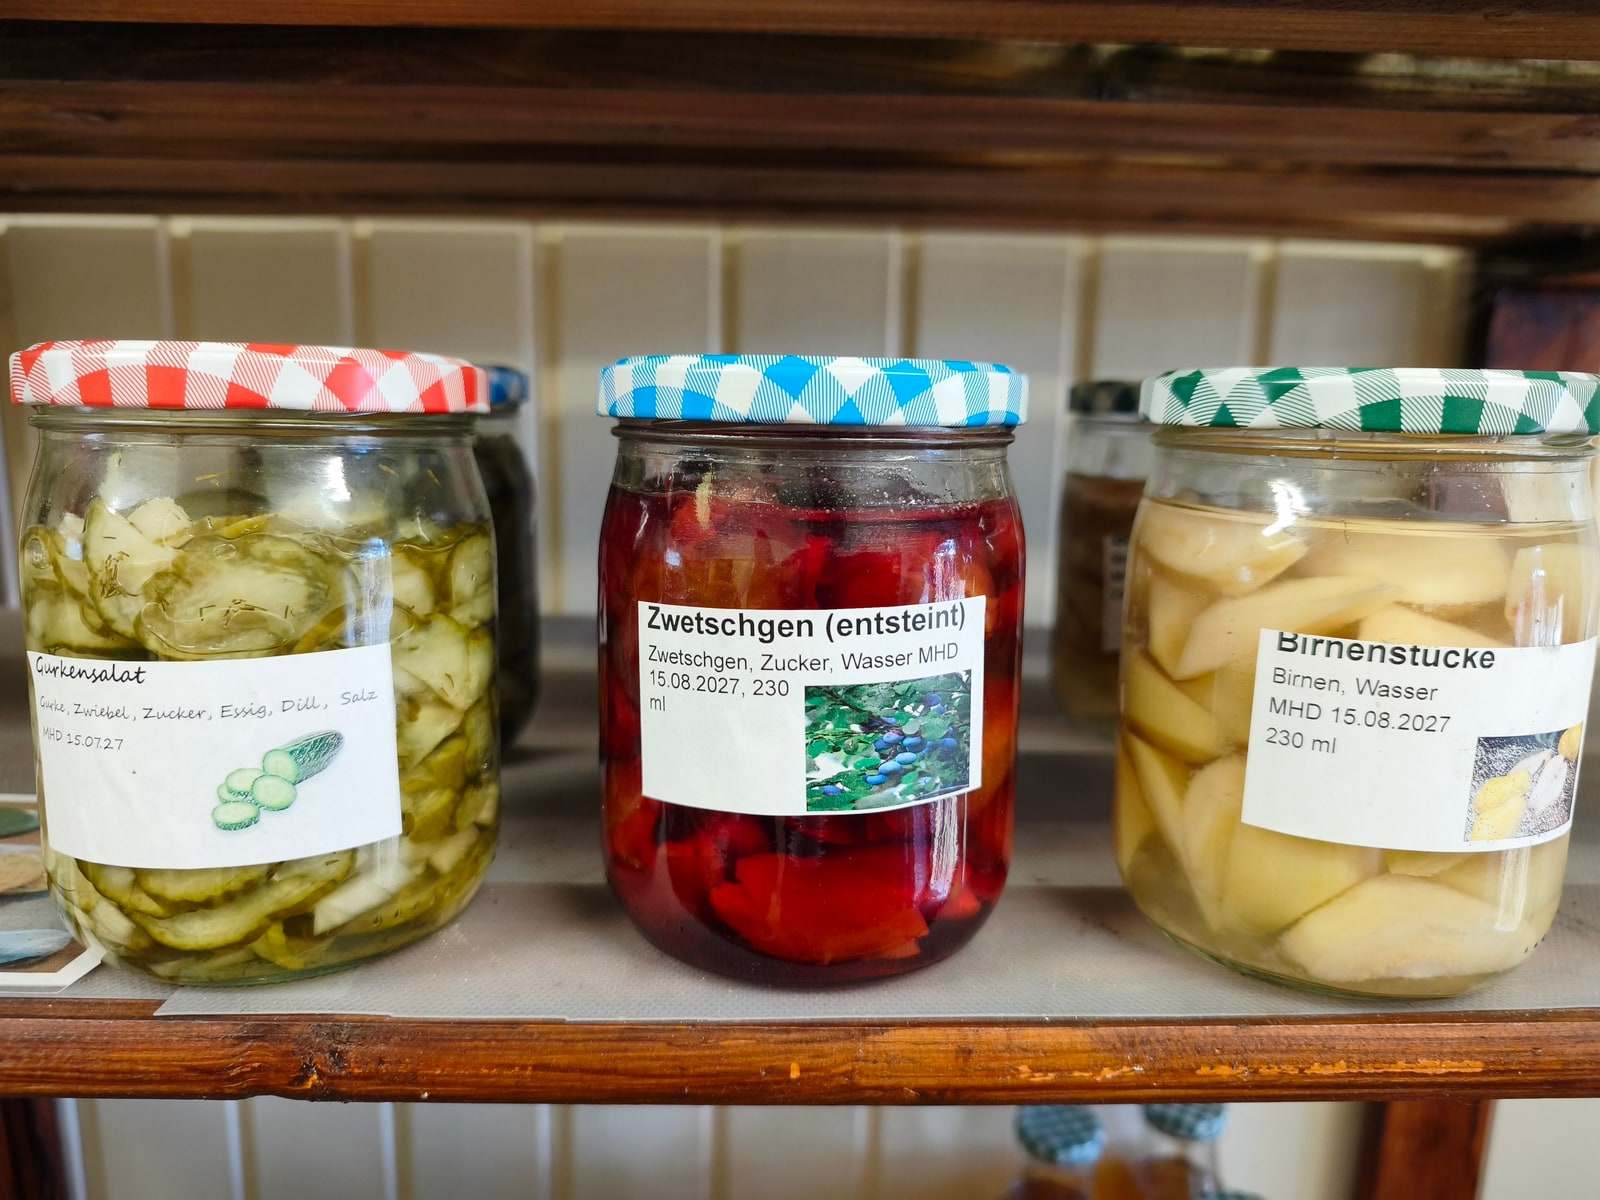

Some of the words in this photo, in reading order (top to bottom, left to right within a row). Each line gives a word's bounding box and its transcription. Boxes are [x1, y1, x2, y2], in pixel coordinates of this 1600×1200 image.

[647, 605, 814, 644] Zwetschgen
[825, 602, 966, 643] (entsteint)
[36, 656, 147, 685] Gurkensalat
[648, 645, 753, 673] Zwetschgen,
[760, 653, 833, 674] Zucker,
[841, 652, 913, 671] Wasser
[918, 642, 959, 664] MHD
[649, 670, 746, 698] 15.08.2027,
[752, 678, 790, 697] 230
[1272, 667, 1345, 696] Birnen,
[1356, 677, 1439, 701] Wasser
[39, 695, 70, 715] Gurke,
[73, 703, 137, 721] Zwiebel,
[142, 707, 214, 721] Zucker,
[220, 703, 273, 719] Essig,
[281, 696, 329, 713] Dill,
[340, 688, 379, 706] Salz
[649, 696, 666, 712] ml
[1268, 697, 1322, 721] MHD
[1332, 707, 1451, 733] 15.08.2027
[42, 727, 62, 742] MHD
[1265, 727, 1304, 749] 230
[1311, 736, 1337, 754] ml
